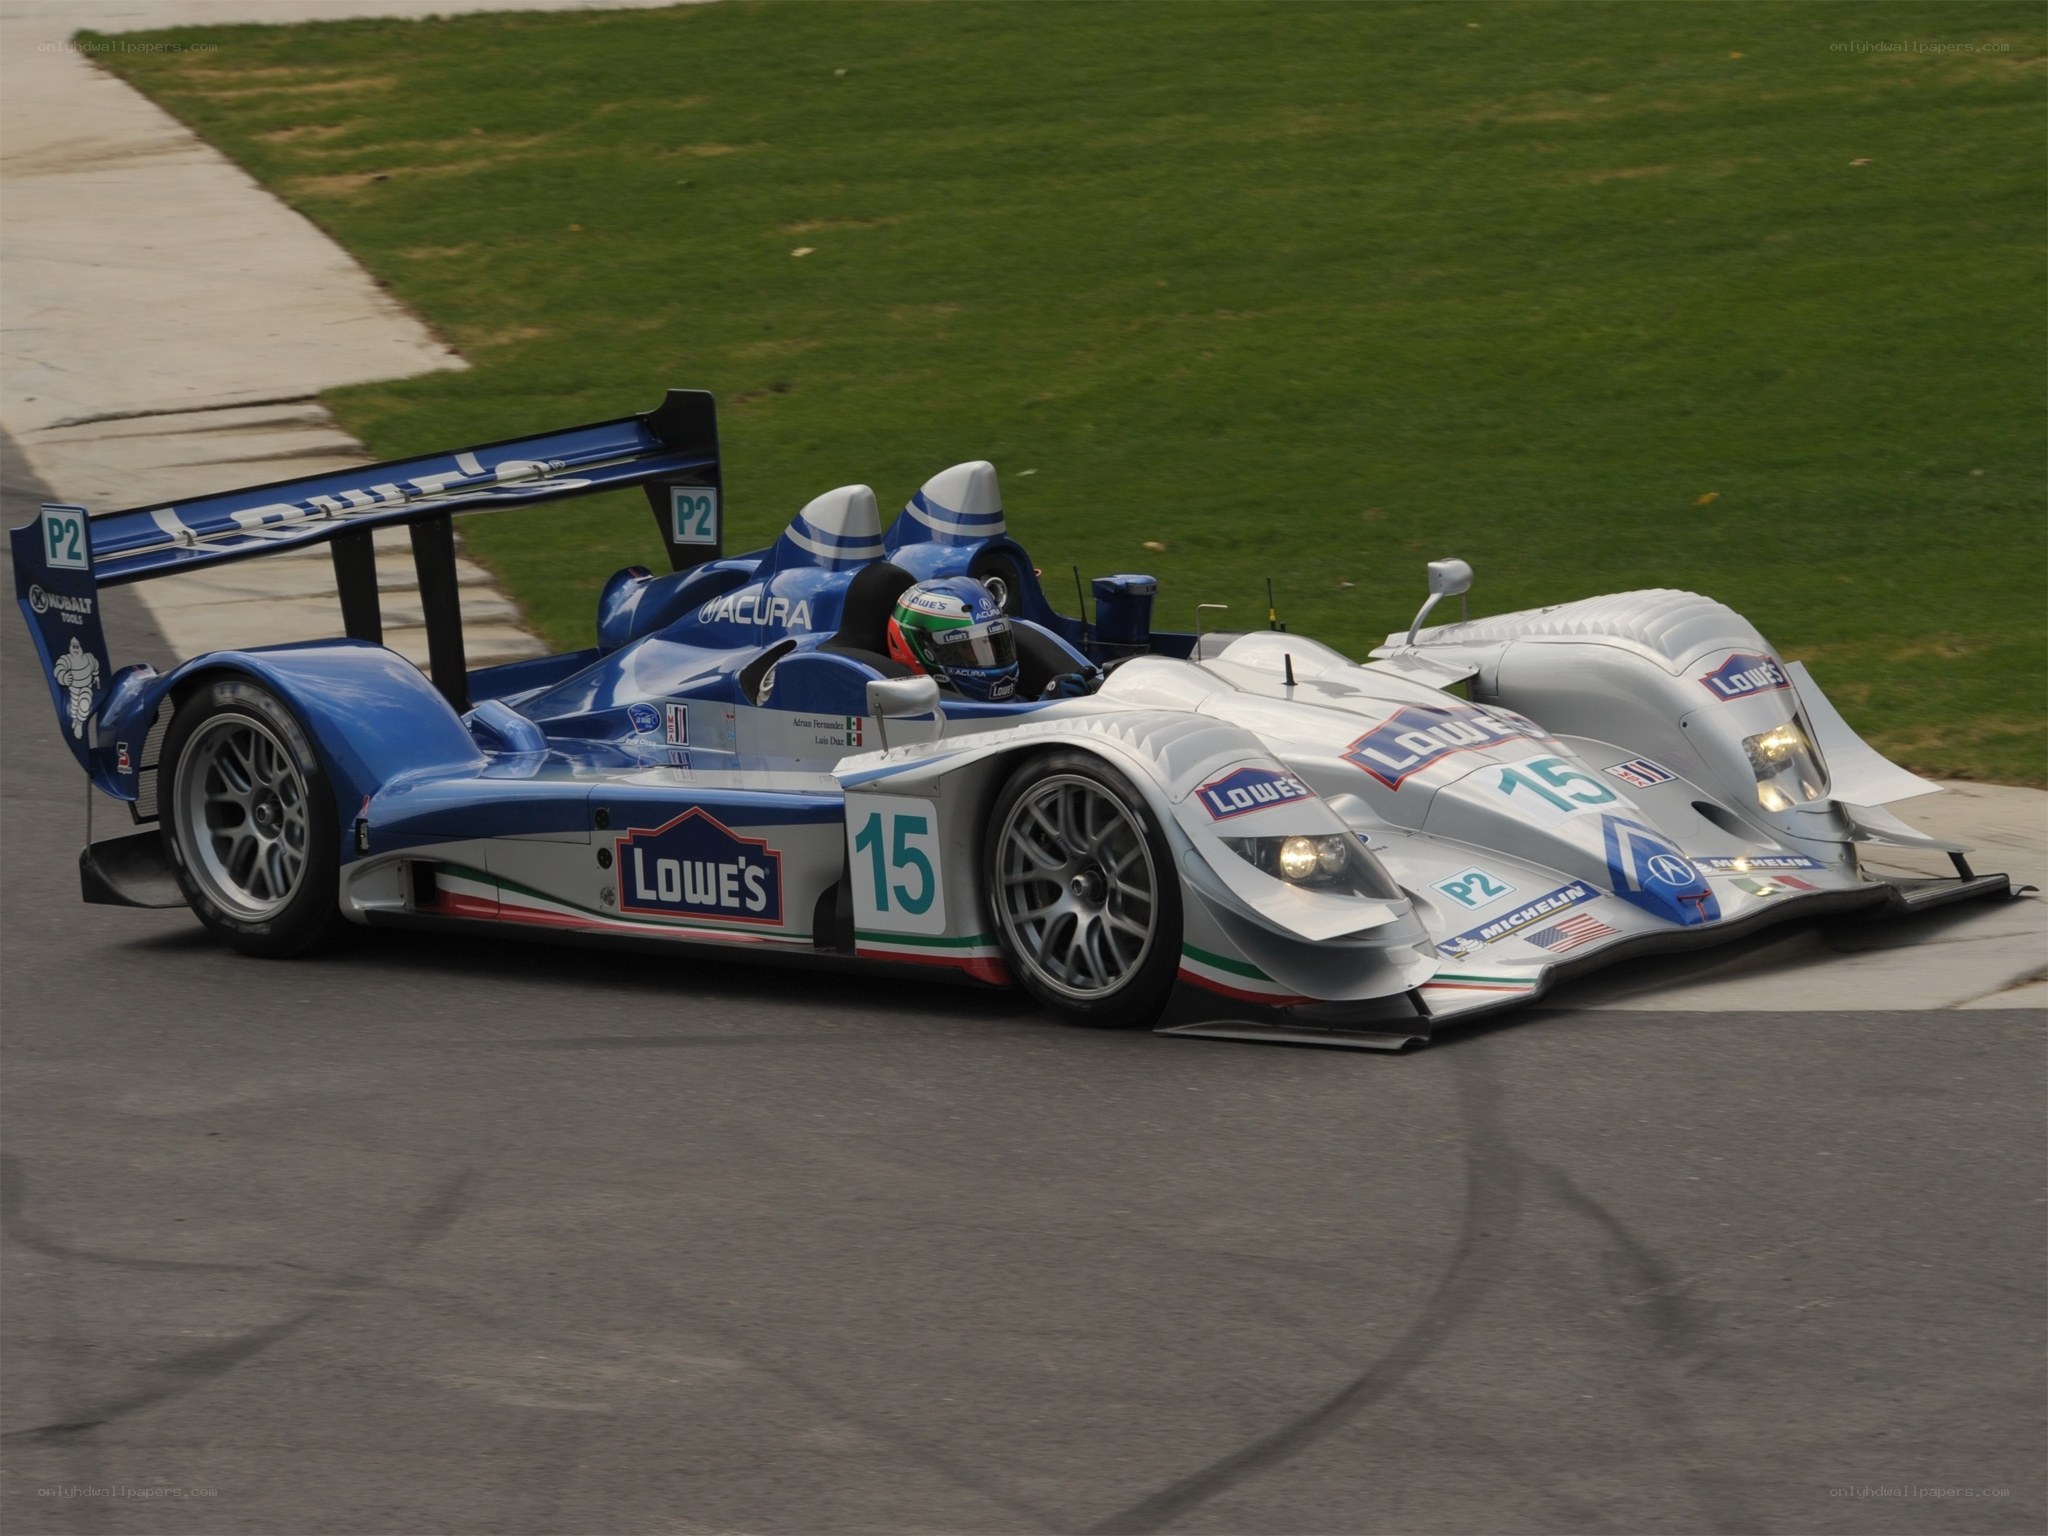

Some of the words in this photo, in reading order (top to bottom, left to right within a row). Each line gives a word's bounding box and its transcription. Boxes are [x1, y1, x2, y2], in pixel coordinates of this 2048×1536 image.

[677, 496, 711, 536] P2
[47, 517, 82, 560] P2
[48, 596, 92, 614] KOBALT
[61, 612, 84, 625] TOOLS
[715, 595, 813, 630] ACURA
[908, 593, 947, 610] LOWE'S
[975, 609, 1001, 620] ACURA
[955, 669, 986, 678] ACURA
[1711, 661, 1784, 695] LOWE'S
[813, 719, 844, 730] Fernandez
[815, 735, 828, 745] Luis
[1207, 776, 1308, 813] LOWE'S
[1498, 755, 1617, 812] 15
[634, 847, 767, 912] LOWE'S
[855, 812, 936, 915] 15
[1710, 858, 1813, 868] MCHELIN
[1440, 872, 1506, 906] P2
[1480, 885, 1586, 939] MICHELIN
